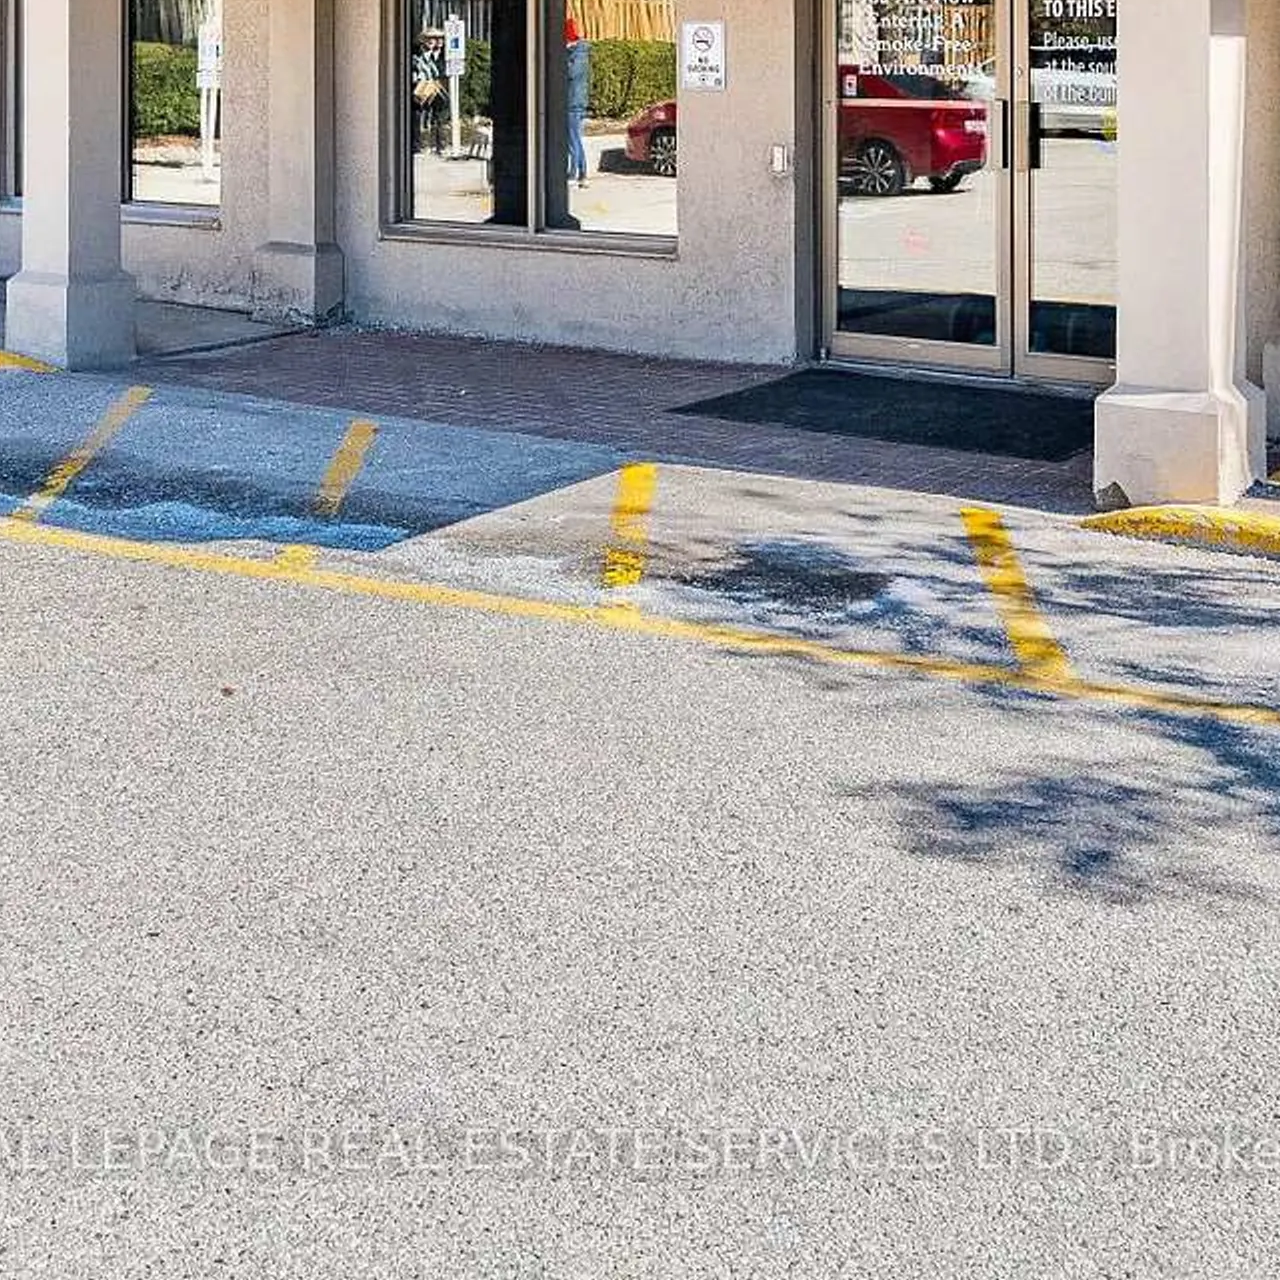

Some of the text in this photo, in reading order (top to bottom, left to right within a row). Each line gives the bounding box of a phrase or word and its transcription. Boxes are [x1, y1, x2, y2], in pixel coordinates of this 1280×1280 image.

[1043, 0, 1063, 18] TO
[1066, 0, 1103, 18] THIS
[864, 36, 972, 52] Smoke-Free
